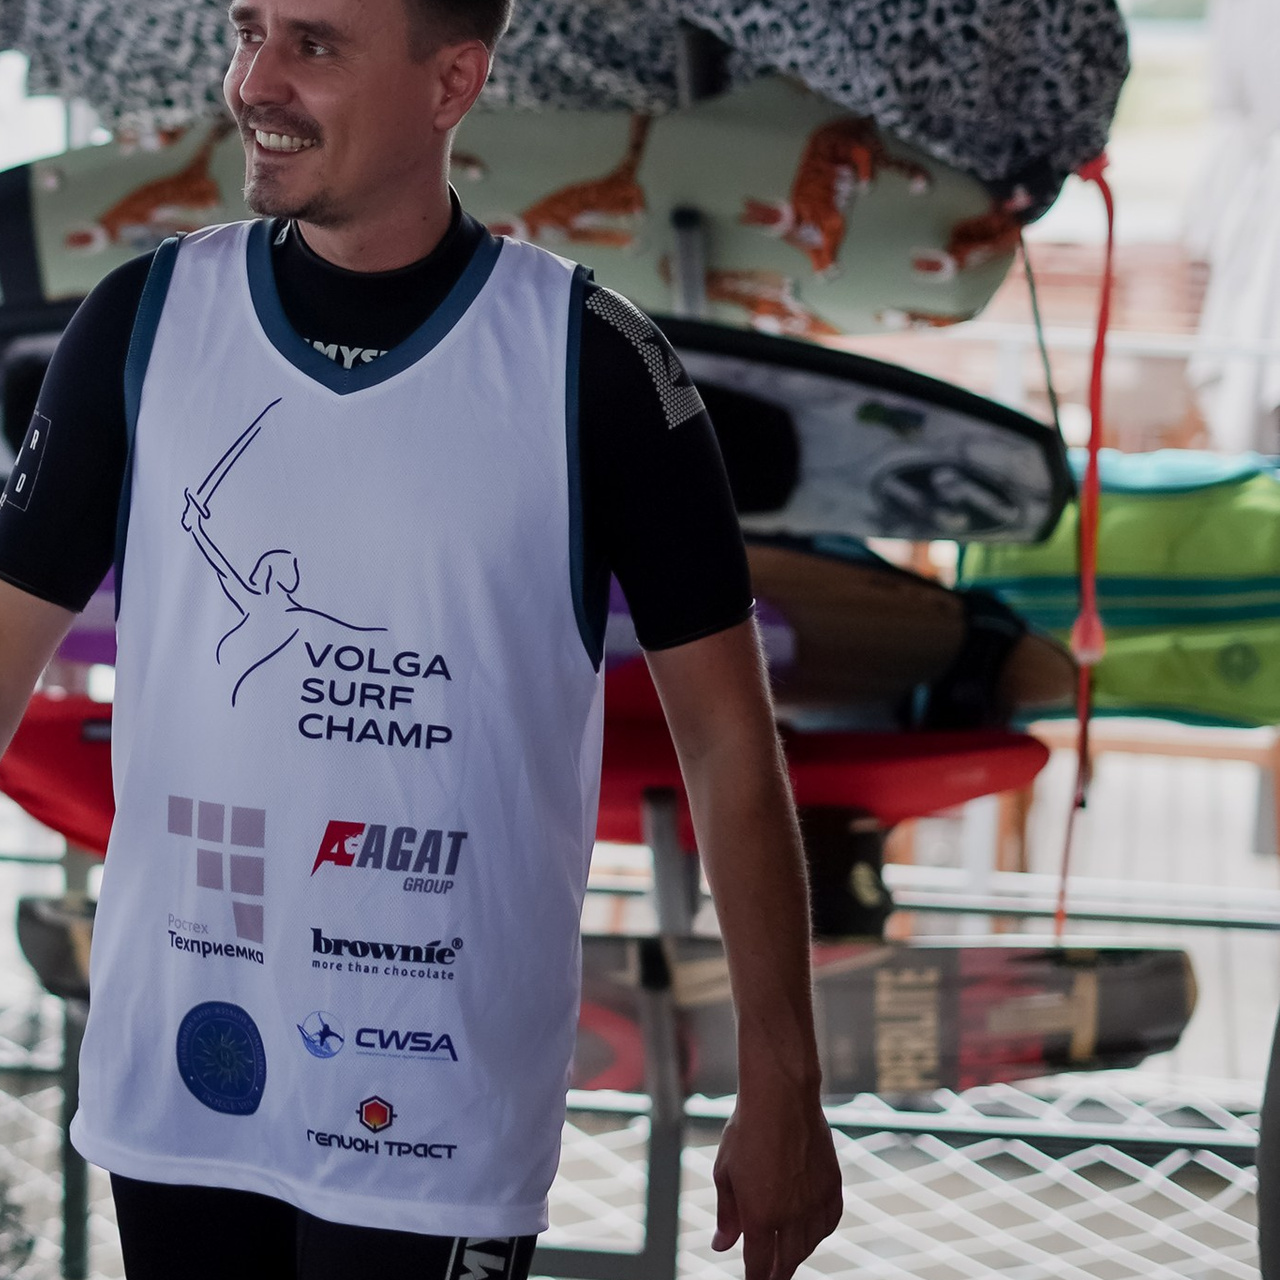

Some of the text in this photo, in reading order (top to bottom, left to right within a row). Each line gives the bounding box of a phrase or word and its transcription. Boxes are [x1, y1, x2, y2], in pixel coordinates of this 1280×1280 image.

[304, 641, 452, 681] VOLGA
[300, 677, 415, 711] SURF
[298, 713, 453, 750] CHAMP
[356, 823, 468, 875] AGAT
[402, 876, 455, 895] GROUP
[167, 913, 210, 935] Ростех
[167, 929, 265, 966] Техприемка
[311, 958, 455, 981] more than chocolate
[355, 1027, 459, 1062] CWSA
